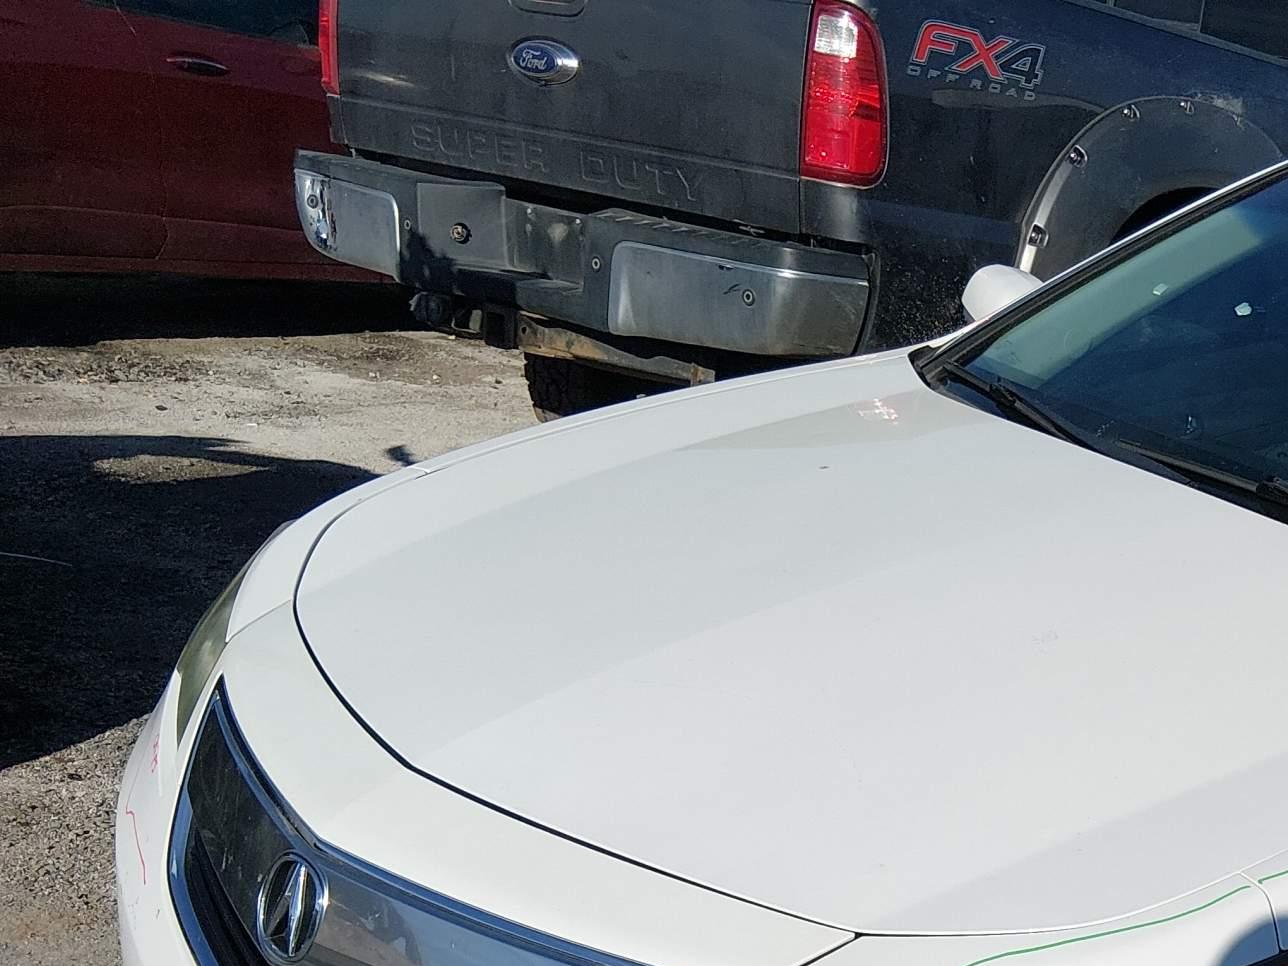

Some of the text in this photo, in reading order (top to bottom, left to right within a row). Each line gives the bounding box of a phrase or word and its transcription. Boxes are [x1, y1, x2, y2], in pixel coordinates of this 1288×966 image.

[520, 48, 548, 70] Ford
[909, 19, 1046, 89] FX4
[906, 65, 1037, 101] OFF ROAD
[411, 124, 699, 201] SUPER DUTY
